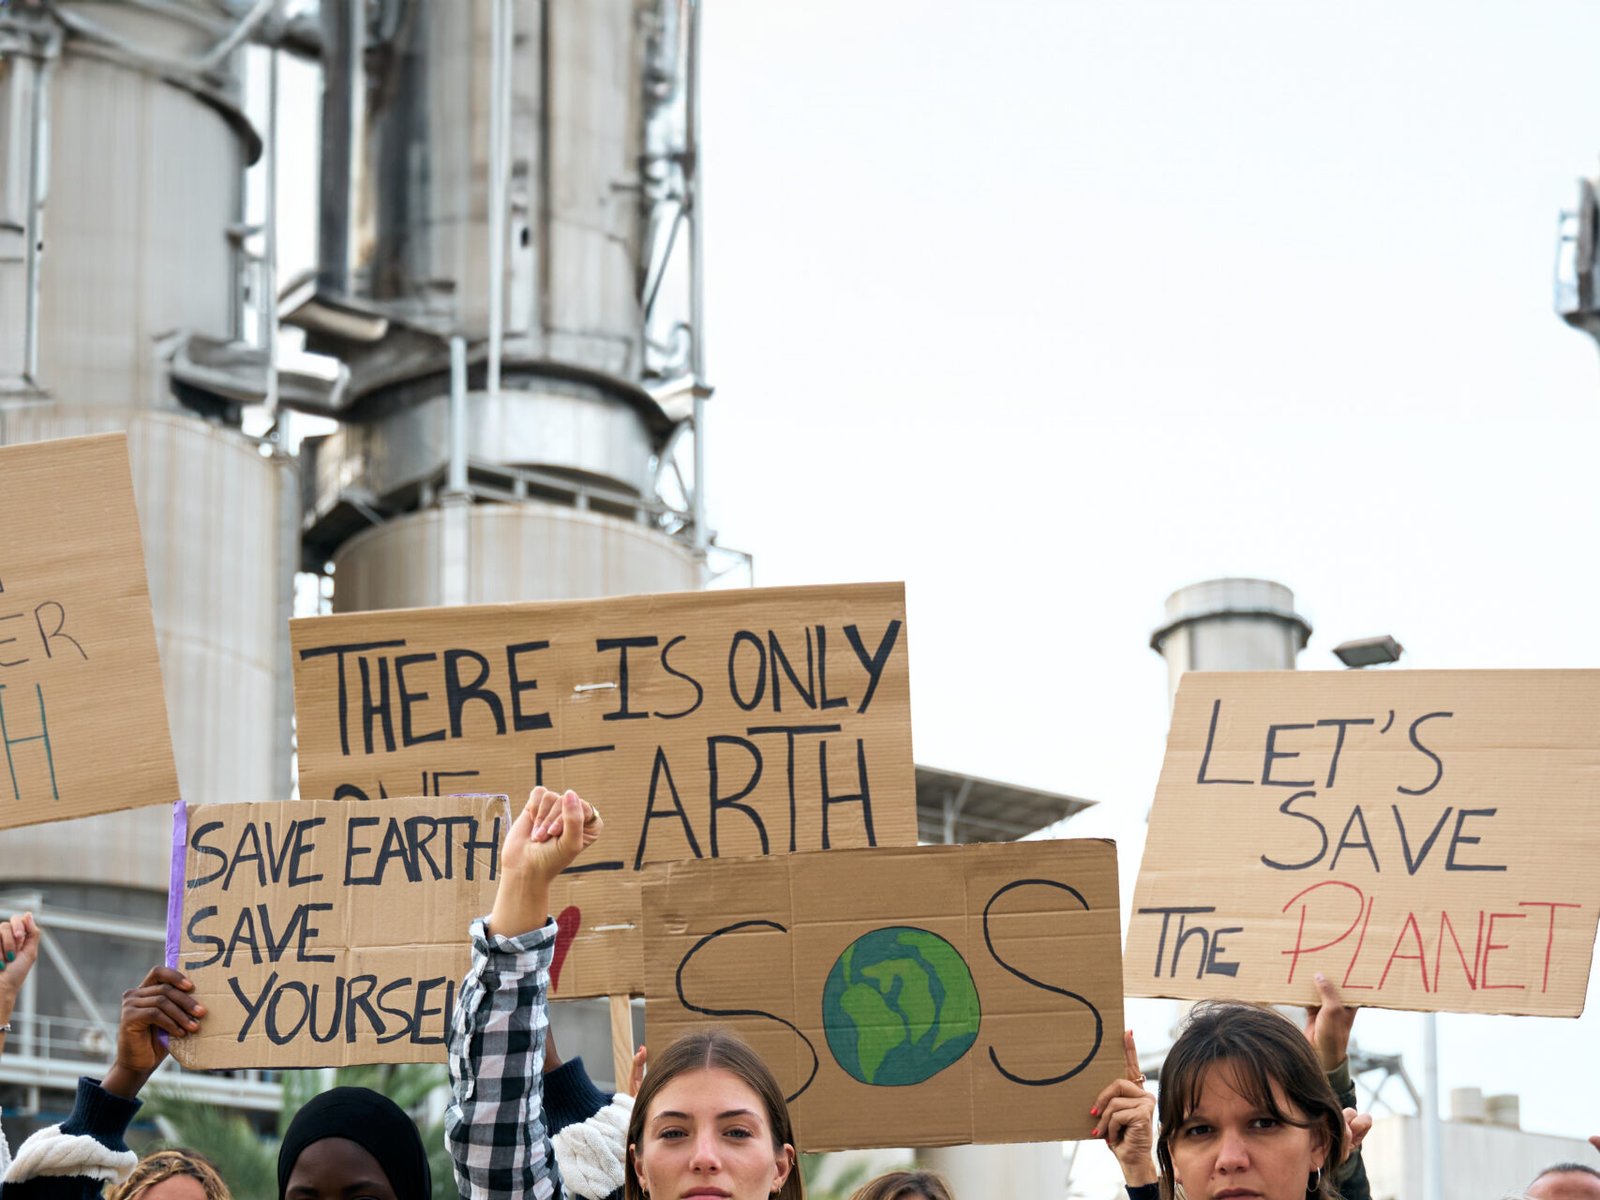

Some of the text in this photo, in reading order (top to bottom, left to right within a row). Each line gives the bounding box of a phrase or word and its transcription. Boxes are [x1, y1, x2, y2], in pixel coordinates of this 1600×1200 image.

[301, 620, 902, 755] THERE IS ONLY
[1197, 699, 1453, 796] LET'S
[187, 815, 500, 890] SAVE EARTH
[1260, 791, 1507, 875] SAVE
[185, 903, 335, 970] SAVE
[1281, 880, 1582, 994] PLANET
[229, 972, 455, 1045] YOURSEL
